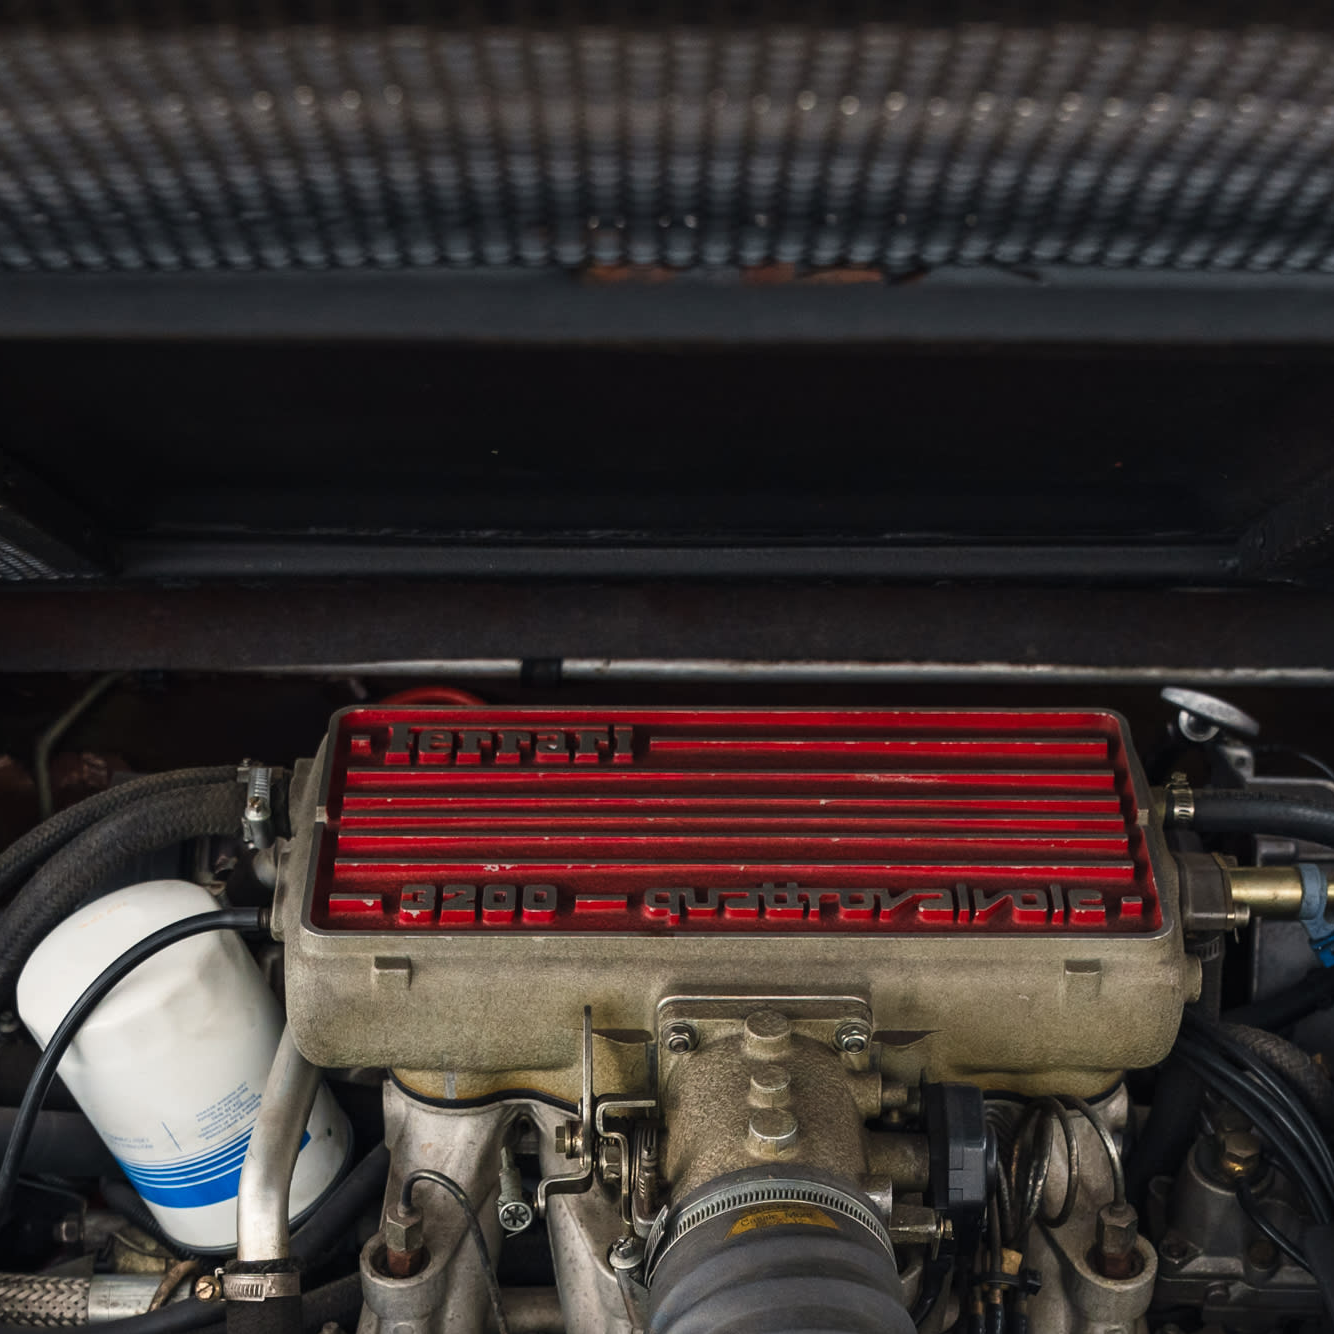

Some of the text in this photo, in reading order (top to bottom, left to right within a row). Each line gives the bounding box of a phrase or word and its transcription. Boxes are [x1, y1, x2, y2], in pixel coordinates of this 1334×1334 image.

[384, 723, 634, 764] Ferrari
[399, 882, 1106, 926] 3200 quattrovalvole
